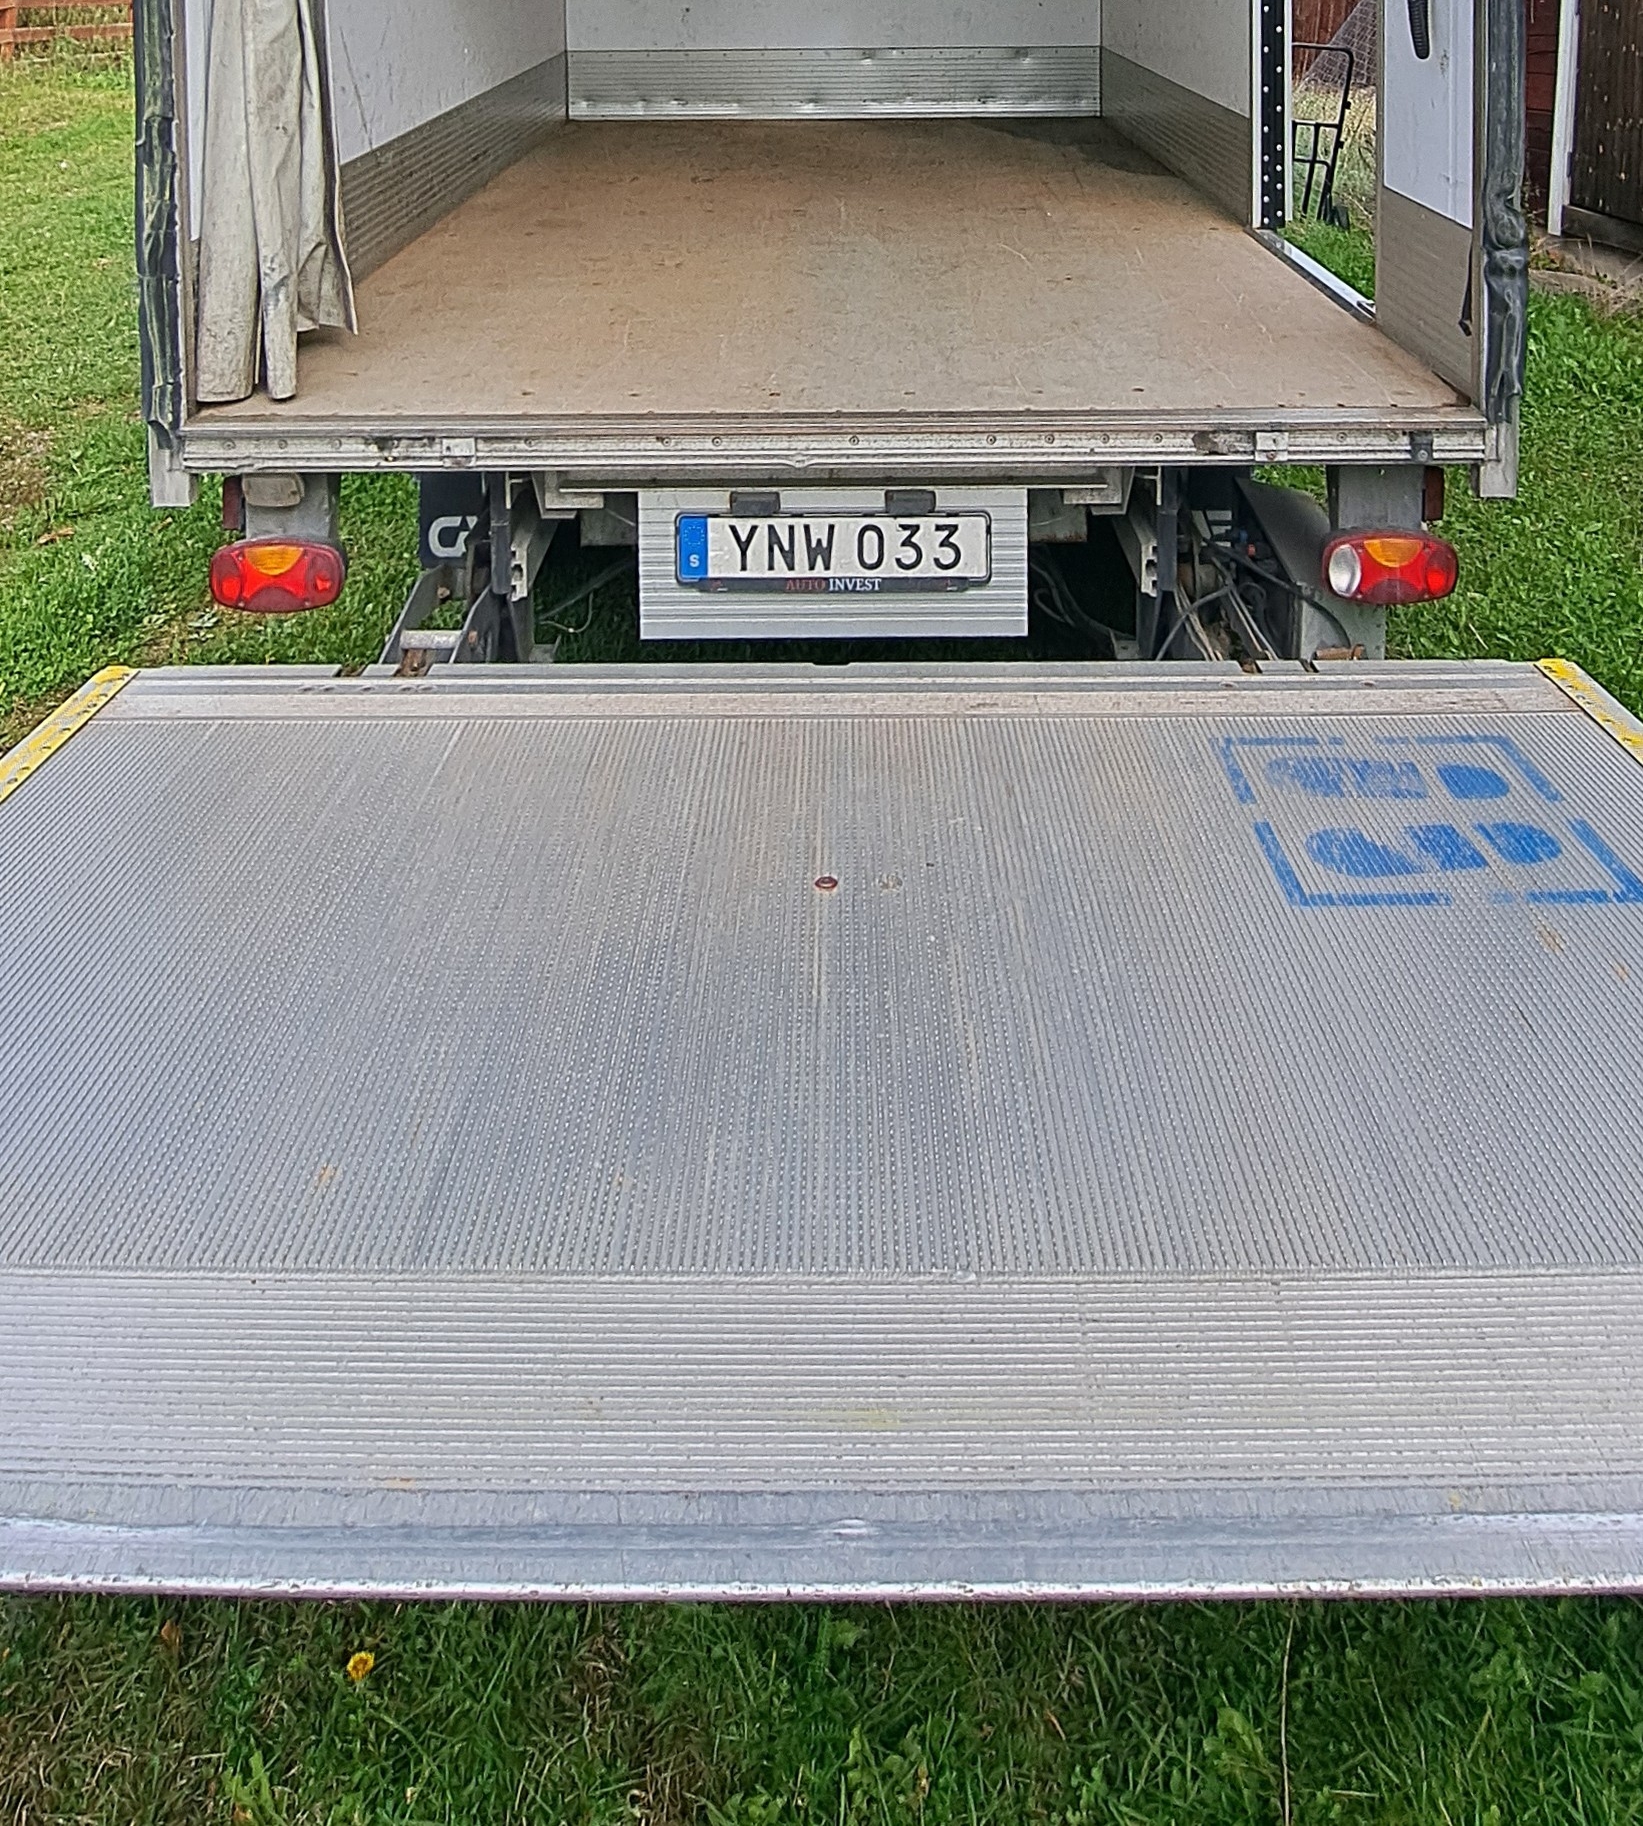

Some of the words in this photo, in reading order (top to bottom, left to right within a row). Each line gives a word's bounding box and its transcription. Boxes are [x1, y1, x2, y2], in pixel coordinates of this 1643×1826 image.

[728, 524, 835, 572] YNW
[856, 523, 962, 571] 033
[689, 554, 700, 568] S
[786, 578, 826, 591] AUTO
[828, 578, 882, 591] INVEST
